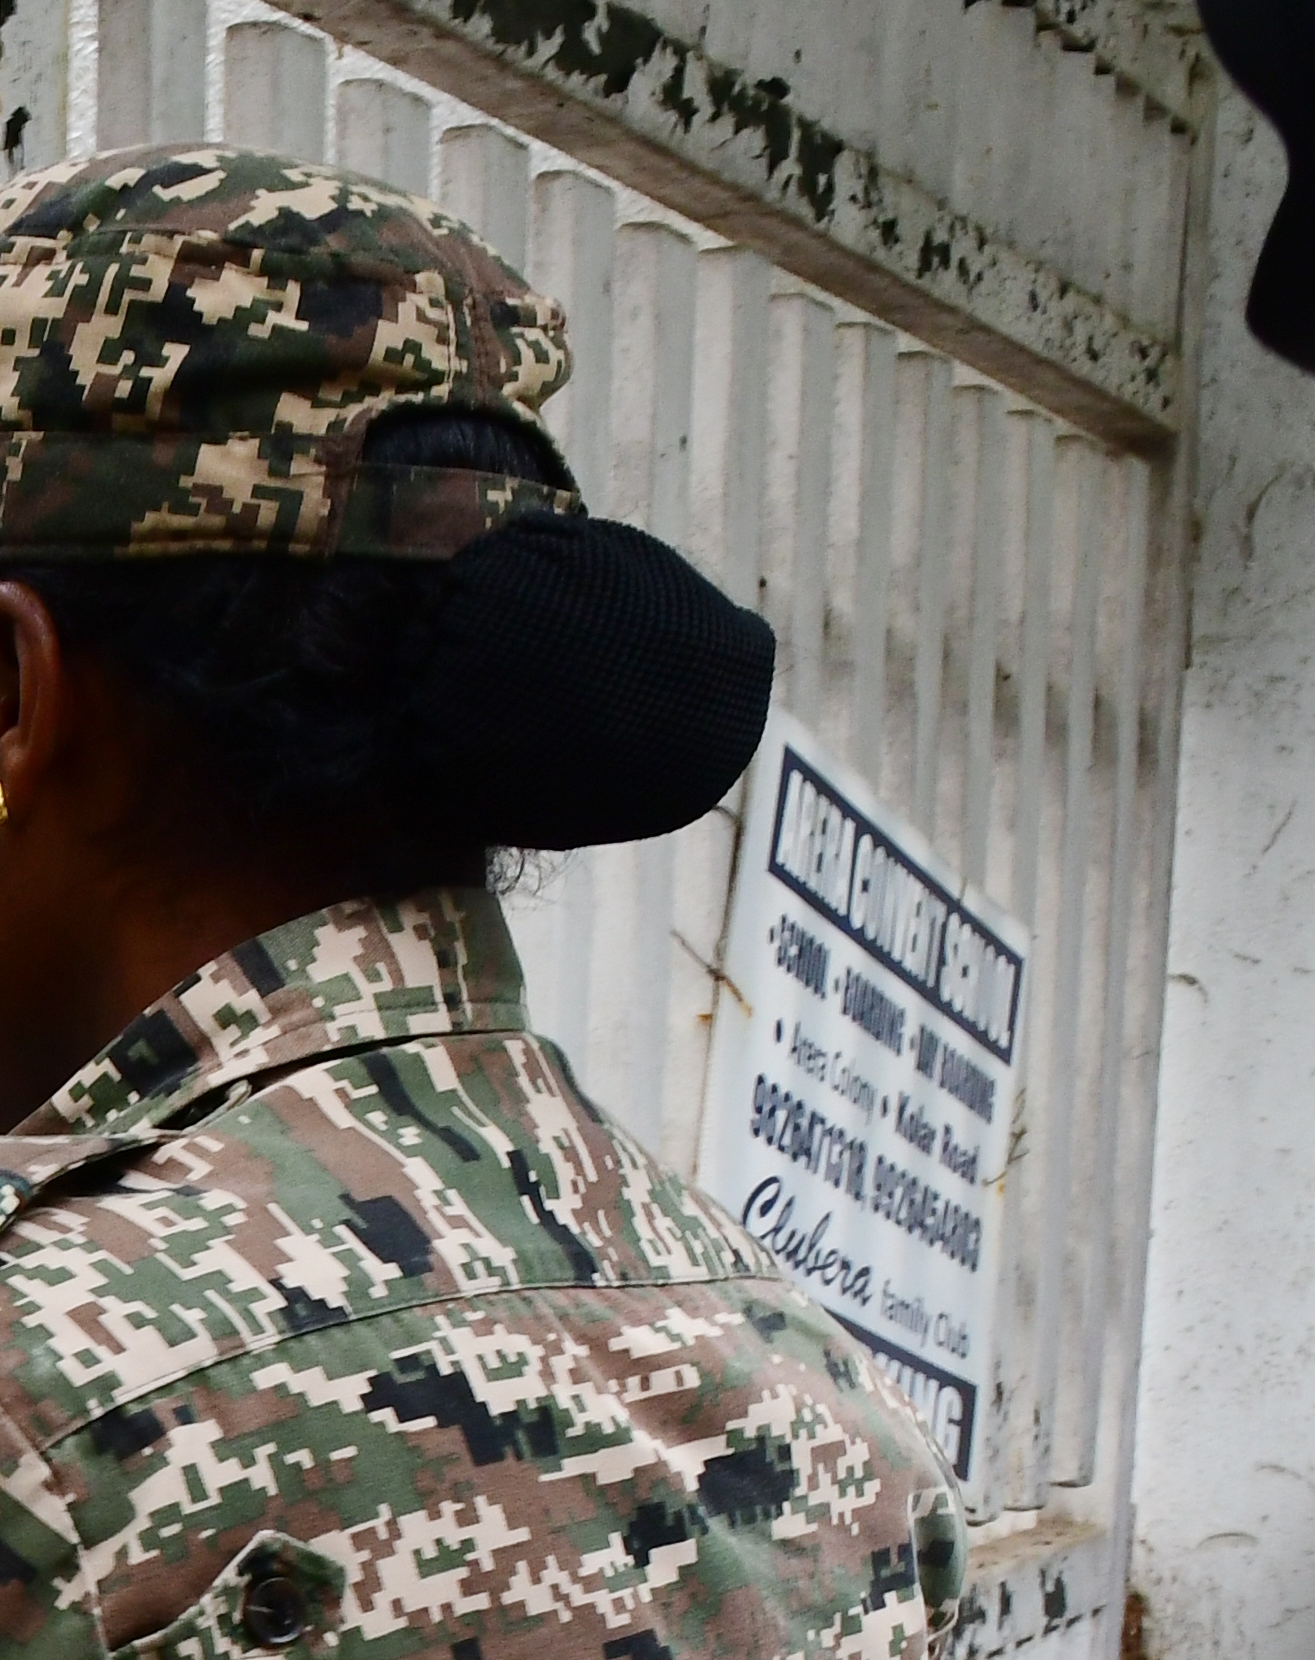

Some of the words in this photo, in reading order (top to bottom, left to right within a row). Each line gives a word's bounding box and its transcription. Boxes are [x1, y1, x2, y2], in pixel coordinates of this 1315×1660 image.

[774, 914, 830, 1000] SCHOOL
[840, 966, 905, 1056] BOARDING
[775, 769, 856, 917] ARERA
[849, 834, 948, 989] CONVENT
[940, 912, 1016, 1049] SCHOOL
[789, 1021, 827, 1082] Arera
[831, 1050, 879, 1126] Colony
[894, 1090, 936, 1154] Kolar
[939, 1123, 980, 1185] Road
[742, 1175, 873, 1307] Clubera
[880, 1278, 930, 1347] family
[933, 1312, 971, 1359] Club
